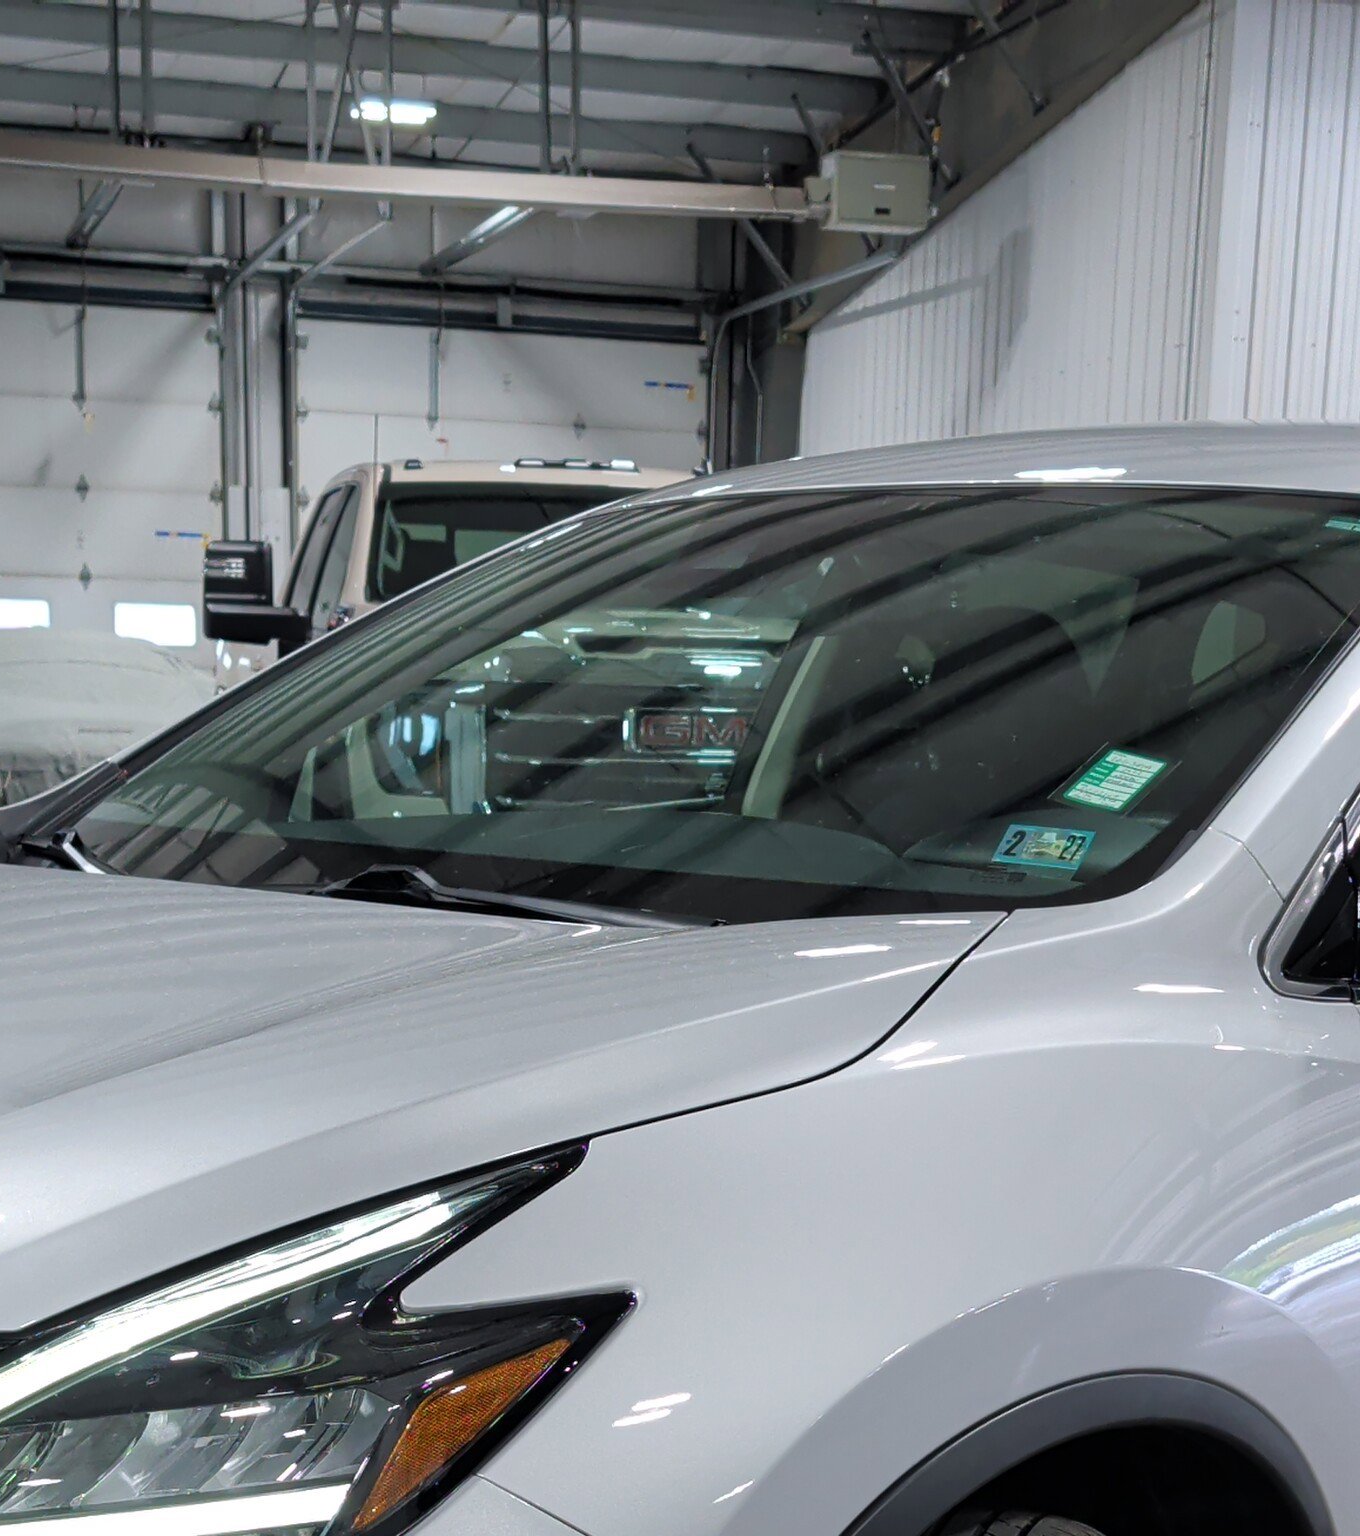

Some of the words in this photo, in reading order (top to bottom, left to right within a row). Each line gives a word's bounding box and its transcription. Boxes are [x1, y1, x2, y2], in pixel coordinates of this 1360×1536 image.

[640, 714, 747, 746] GM
[1002, 830, 1027, 856] 2
[1058, 834, 1087, 861] 27
